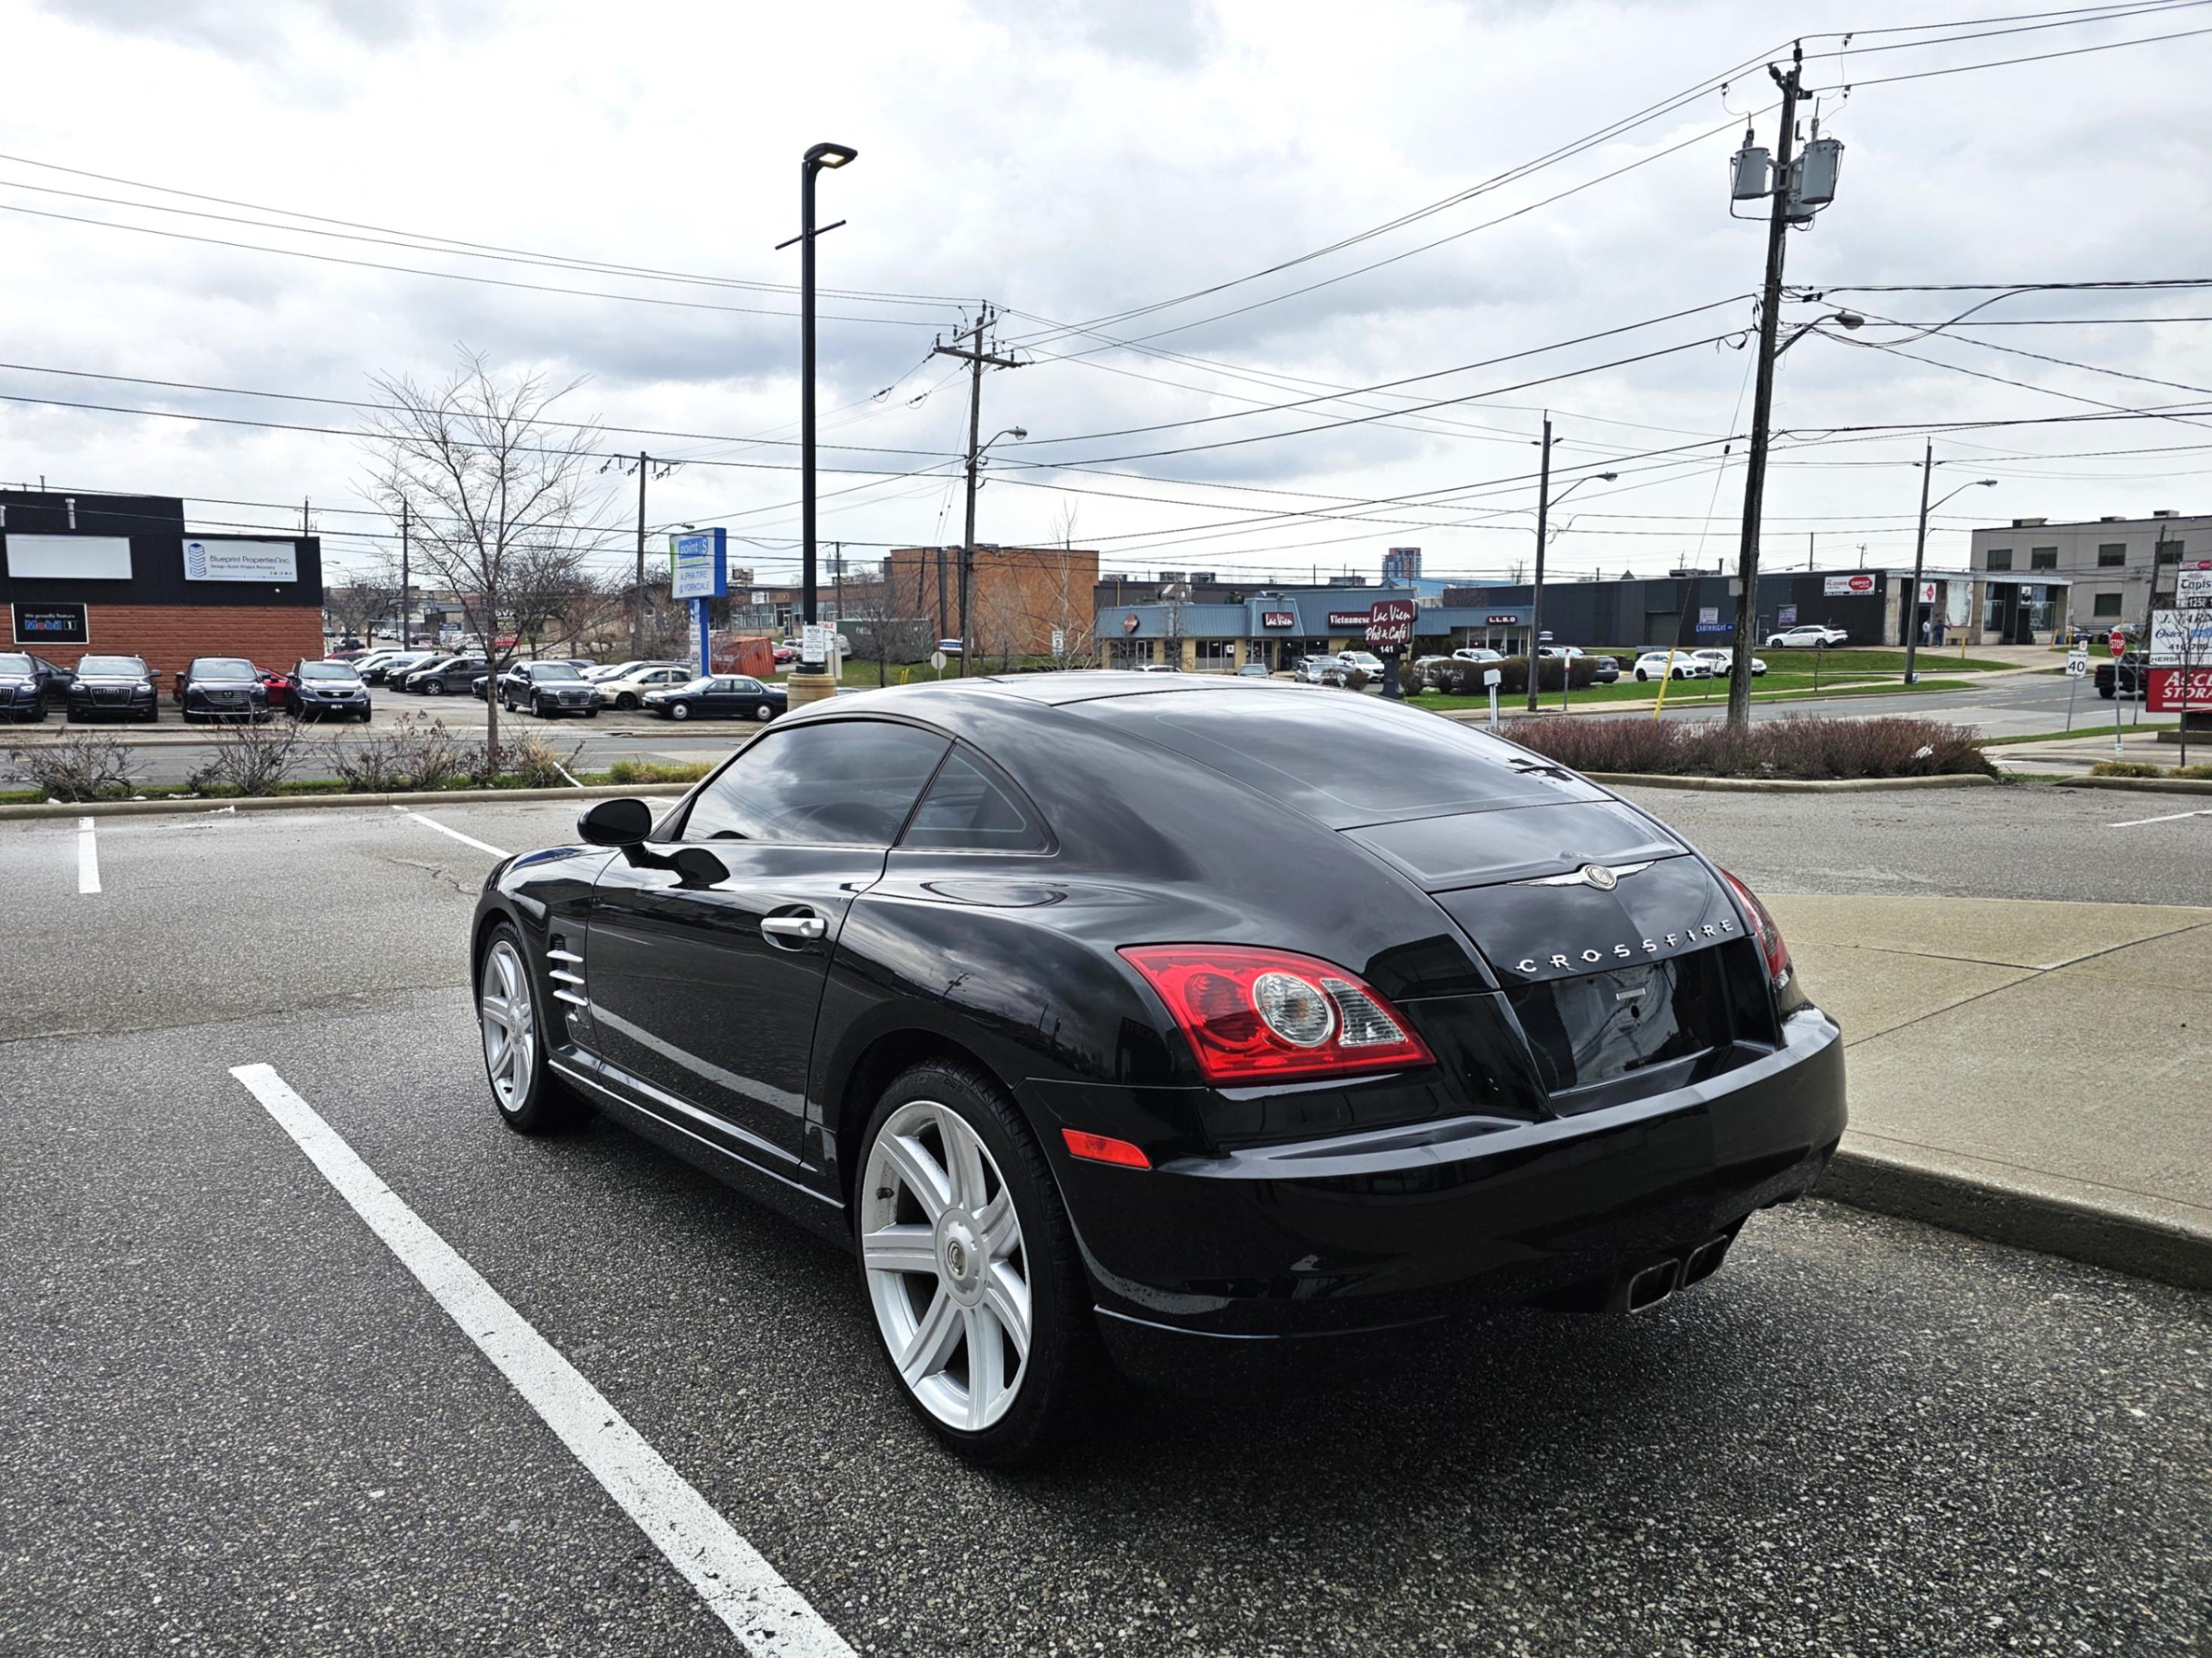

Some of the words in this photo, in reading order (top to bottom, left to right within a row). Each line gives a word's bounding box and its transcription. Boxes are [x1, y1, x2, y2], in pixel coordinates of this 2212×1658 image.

[210, 555, 241, 564] Blueprint
[1373, 605, 1389, 622] Lac
[1389, 604, 1410, 622] Vien
[1265, 613, 1277, 625] Lac
[1277, 613, 1293, 625] Vien
[1330, 615, 1370, 624] Vietnamese
[24, 620, 62, 631] Mobil
[1696, 624, 1727, 632] CARTWRIGHT
[1388, 623, 1407, 643] Café
[1380, 645, 1394, 653] 141
[2110, 639, 2125, 649] STOP
[2068, 661, 2085, 672] 40
[1516, 919, 1733, 974] CROSSFIRE
